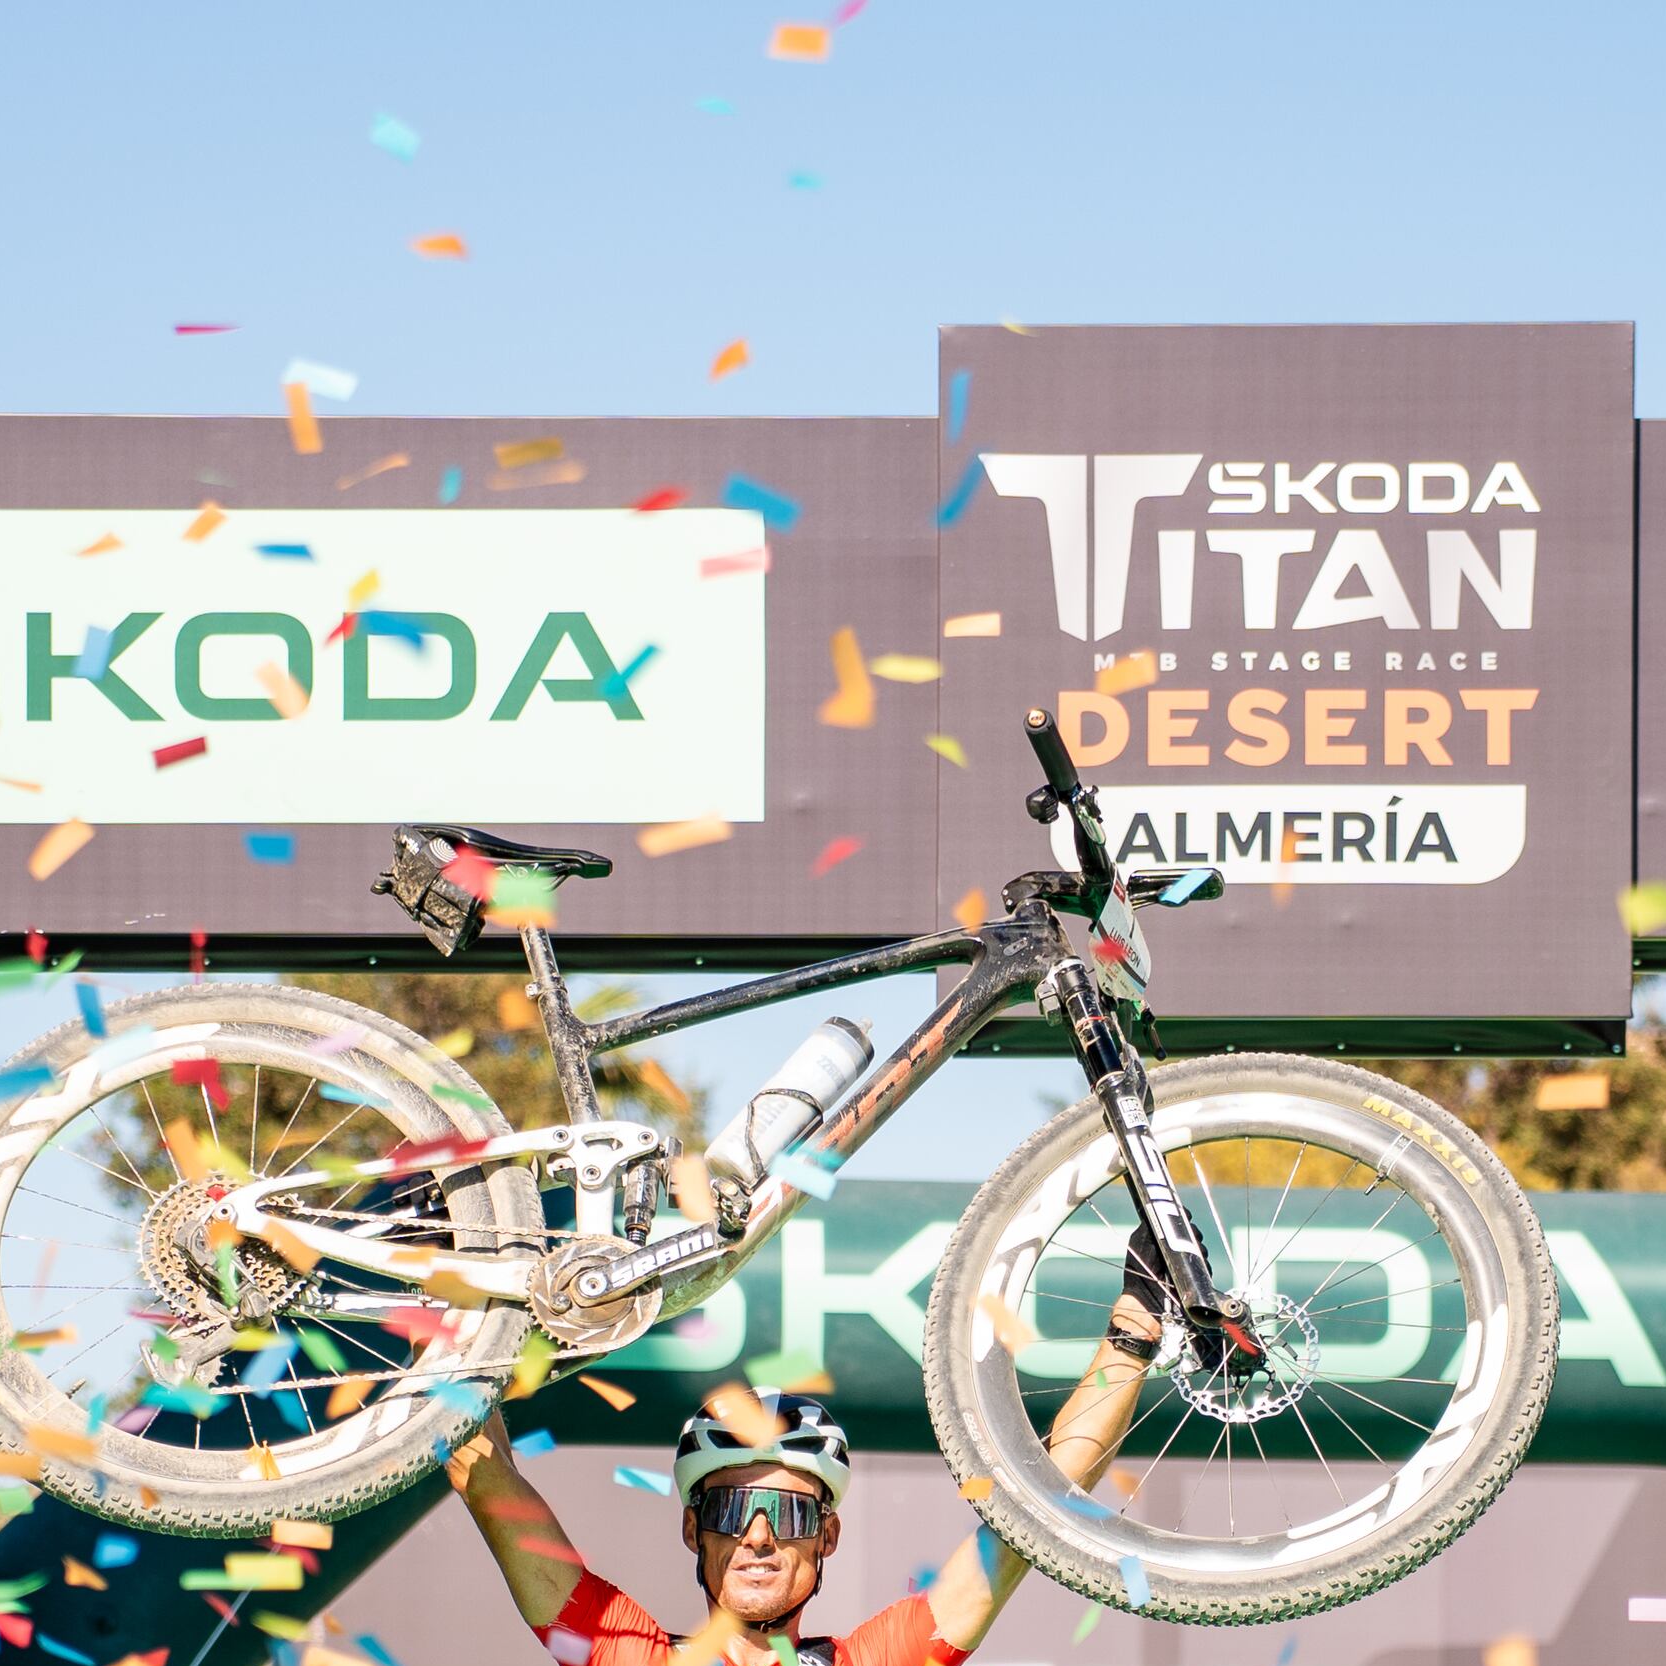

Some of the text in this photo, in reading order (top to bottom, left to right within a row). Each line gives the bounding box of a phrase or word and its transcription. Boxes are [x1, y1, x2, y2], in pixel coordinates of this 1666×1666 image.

[1206, 461, 1542, 514] SKODA
[977, 453, 1538, 642] TITAN
[1211, 651, 1352, 671] STAGE
[1384, 651, 1499, 671] RACE
[1057, 688, 1540, 767] DESERT
[1115, 795, 1459, 864] ALMERÍA
[611, 1231, 715, 1289] SRAM
